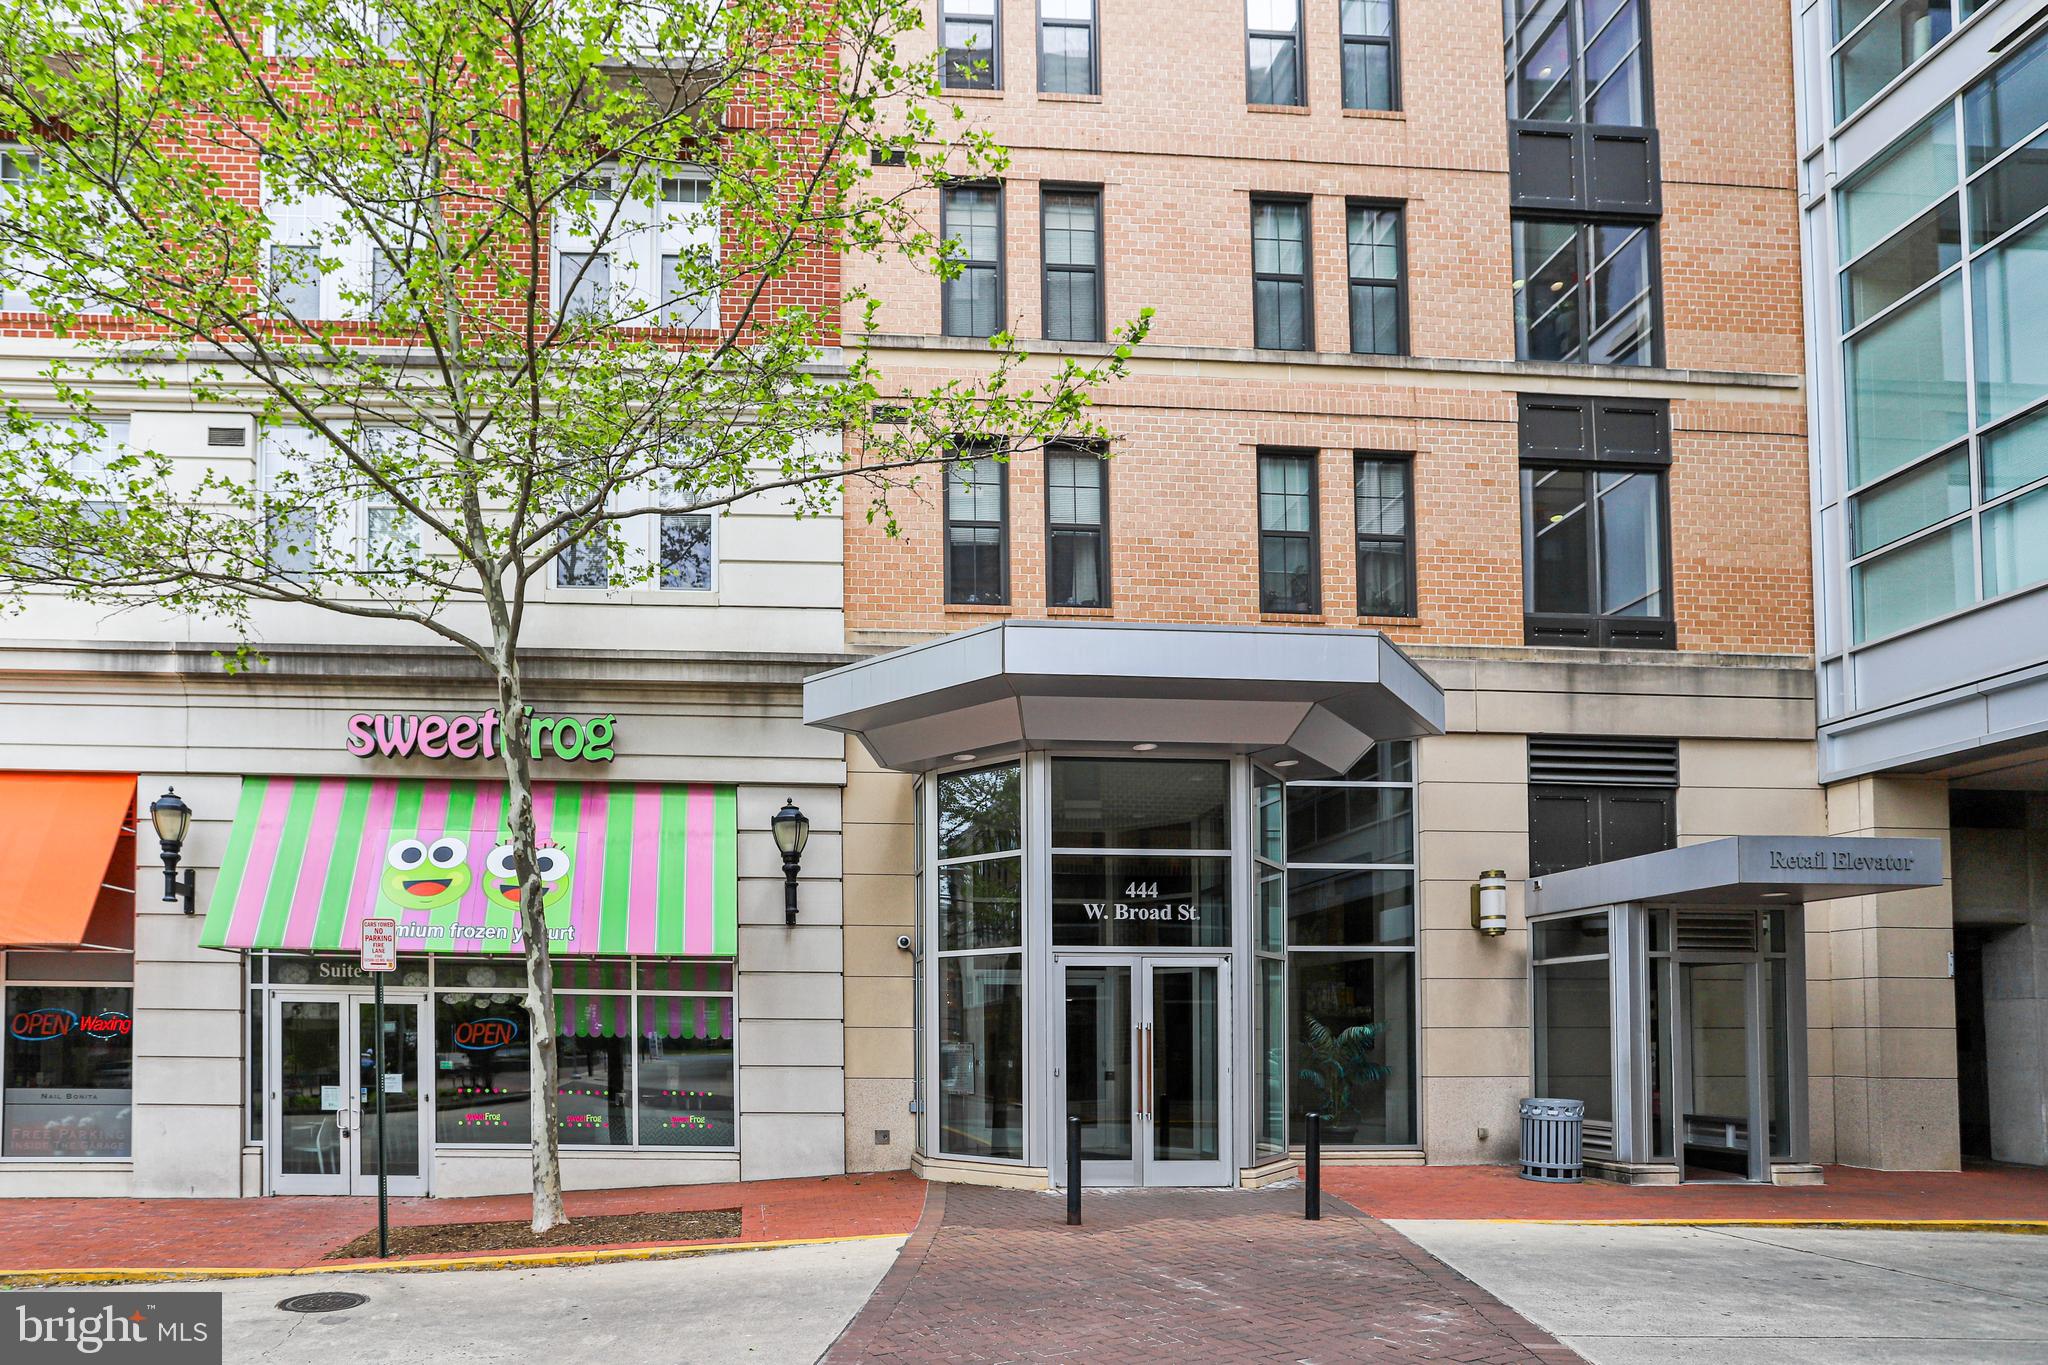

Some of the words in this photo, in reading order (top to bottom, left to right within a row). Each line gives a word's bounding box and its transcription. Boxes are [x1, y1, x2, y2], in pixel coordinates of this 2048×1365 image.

[1770, 851, 1827, 869] Retail
[1833, 852, 1914, 871] Elevator
[1125, 882, 1158, 898] 444
[1083, 904, 1109, 919] W.
[1114, 904, 1172, 920] Broad
[1178, 904, 1200, 920] St.
[397, 922, 444, 939] mium
[450, 922, 507, 940] frozen
[512, 926, 574, 943] yurt
[320, 962, 362, 978] Suite
[12, 1013, 71, 1035] OPEN
[80, 1015, 132, 1034] Waxing
[456, 1022, 512, 1044] OPEN
